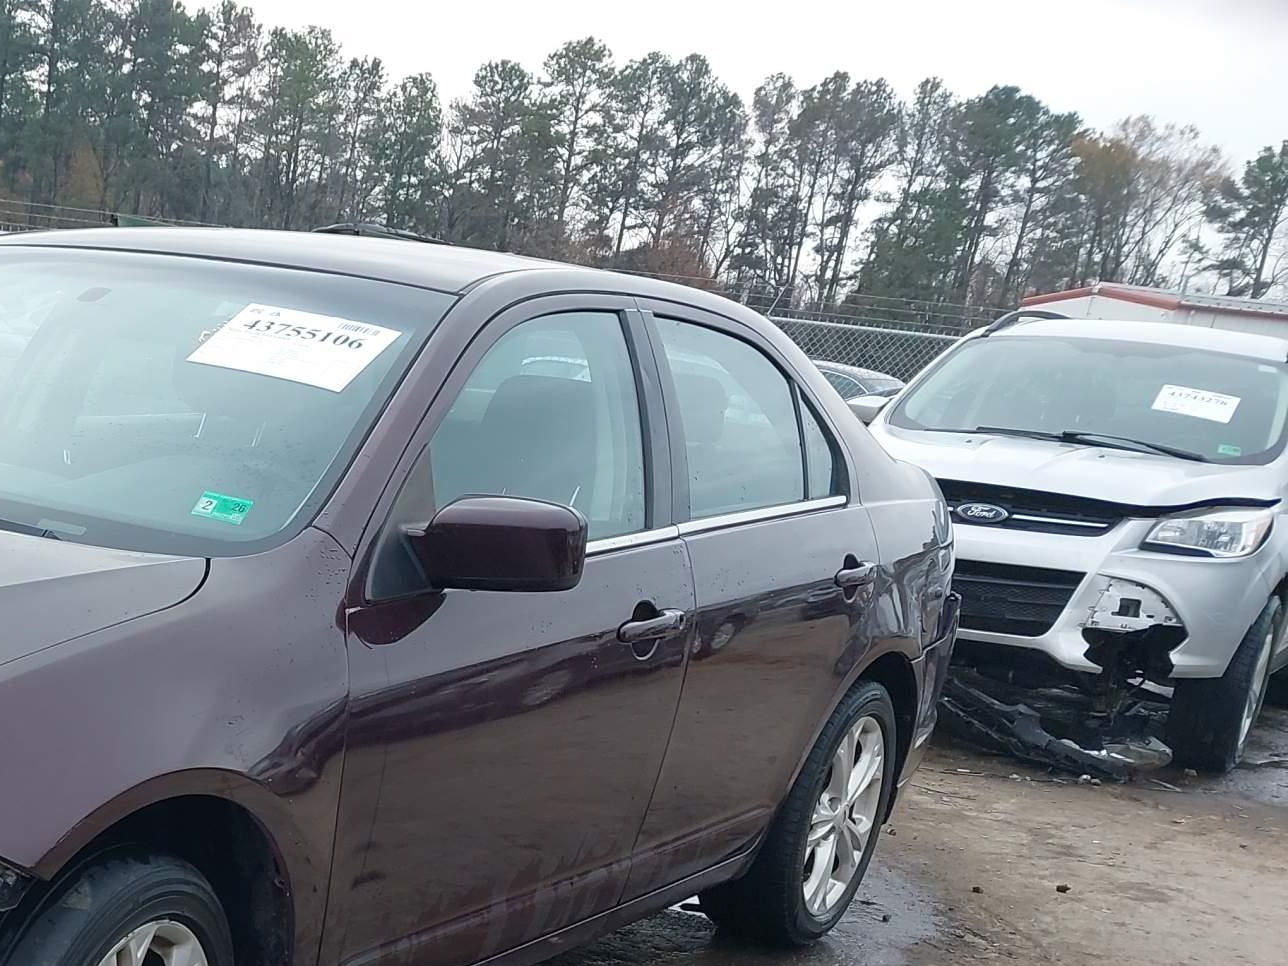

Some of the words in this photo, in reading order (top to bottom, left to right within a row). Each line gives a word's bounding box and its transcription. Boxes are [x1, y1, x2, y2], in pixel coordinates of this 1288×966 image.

[243, 319, 367, 350] 43755106
[201, 500, 214, 511] 2
[967, 505, 997, 518] Ford
